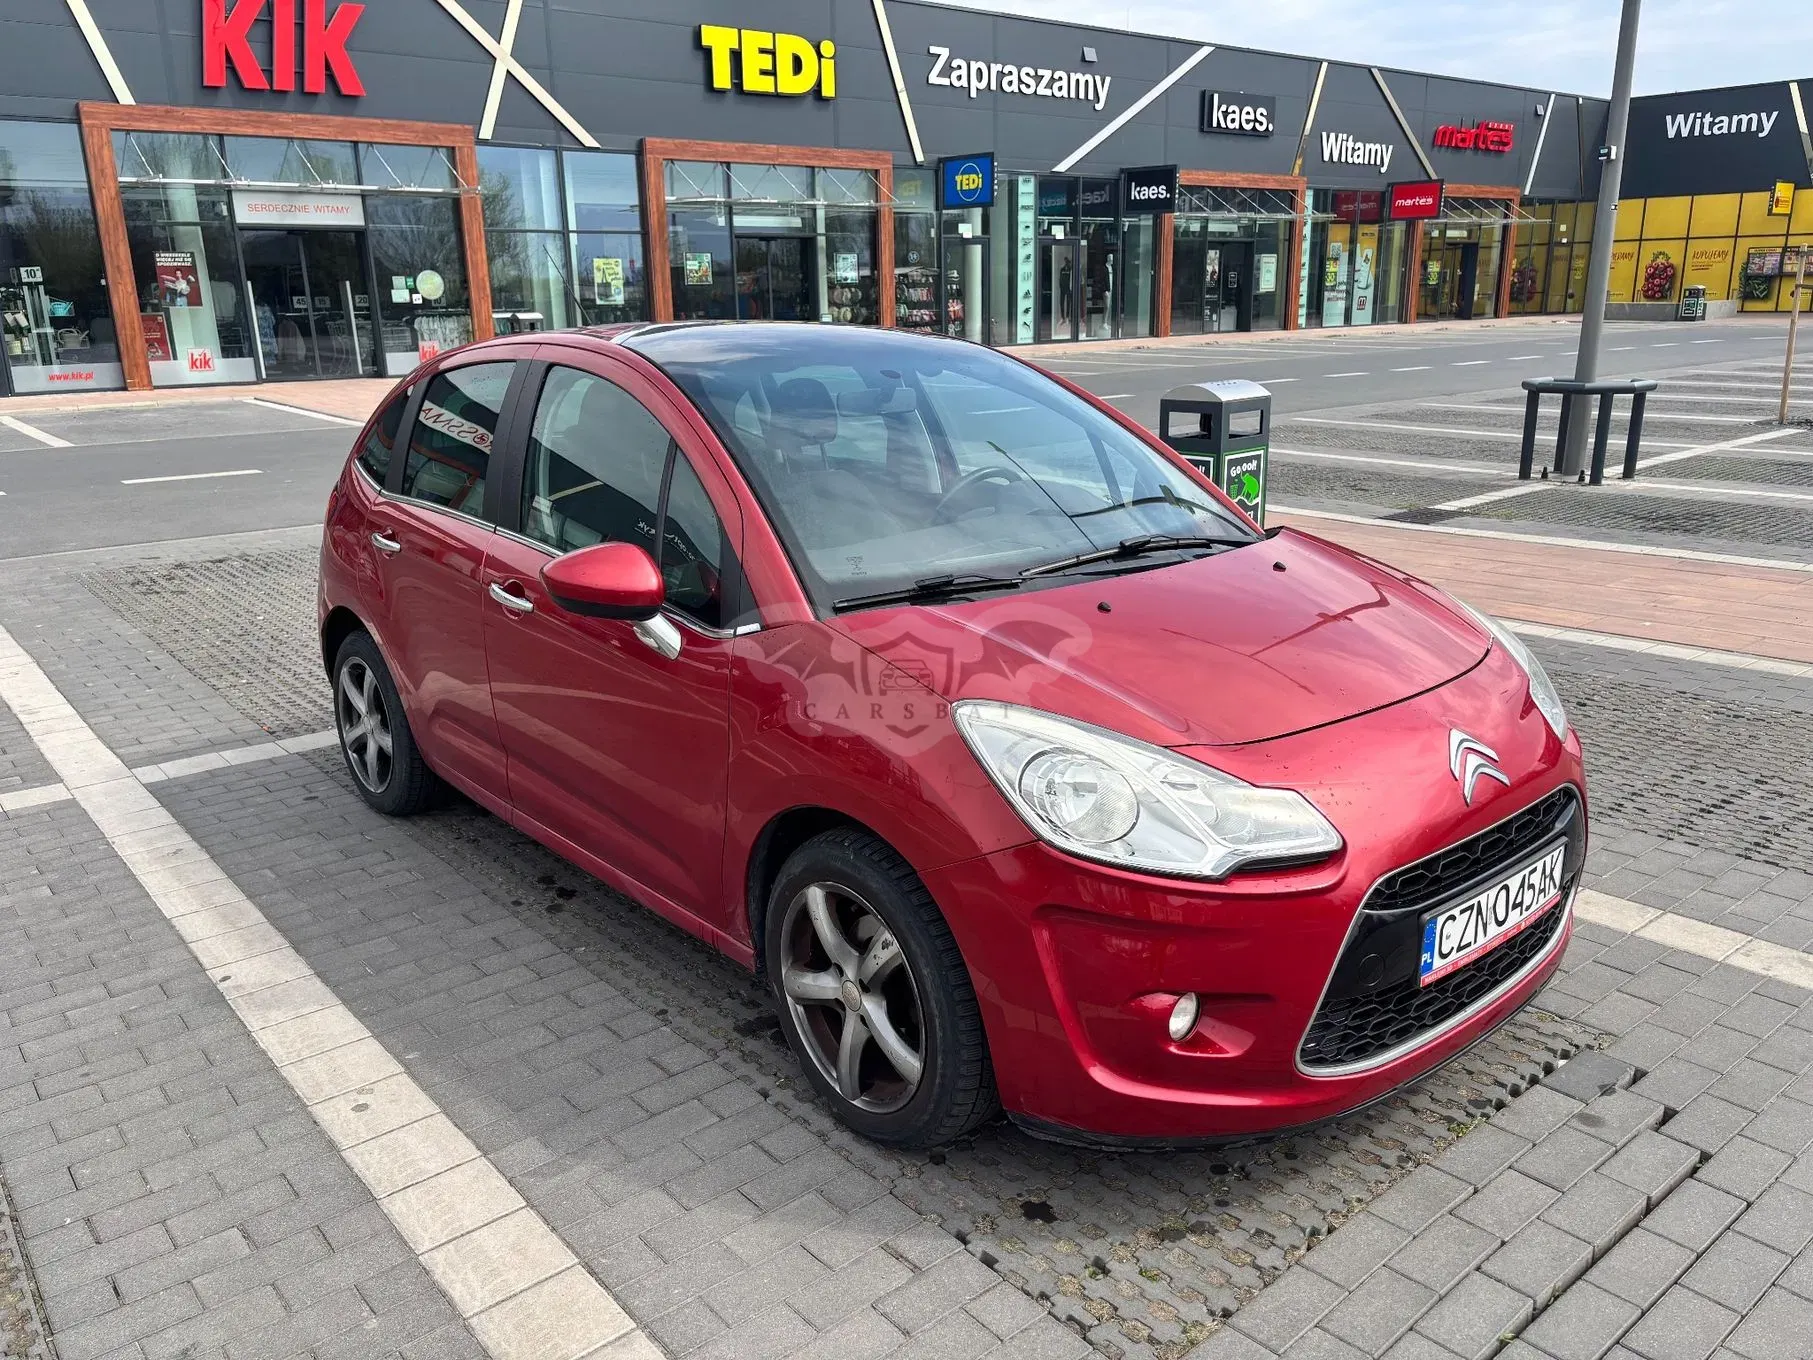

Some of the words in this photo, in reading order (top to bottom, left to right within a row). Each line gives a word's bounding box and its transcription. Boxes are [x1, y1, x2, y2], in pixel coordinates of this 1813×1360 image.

[701, 24, 836, 98] TEDi
[928, 45, 1111, 111] Zapraszamy
[1665, 110, 1779, 139] Witamy
[1321, 131, 1394, 174] Witamy
[955, 173, 982, 191] TEDi
[247, 203, 310, 213] SERDECZNIE
[313, 205, 351, 214] WITAMY
[1395, 196, 1433, 207] martes
[190, 349, 213, 370] kik
[48, 371, 94, 382] www.kik.pl
[1421, 951, 1433, 967] PL
